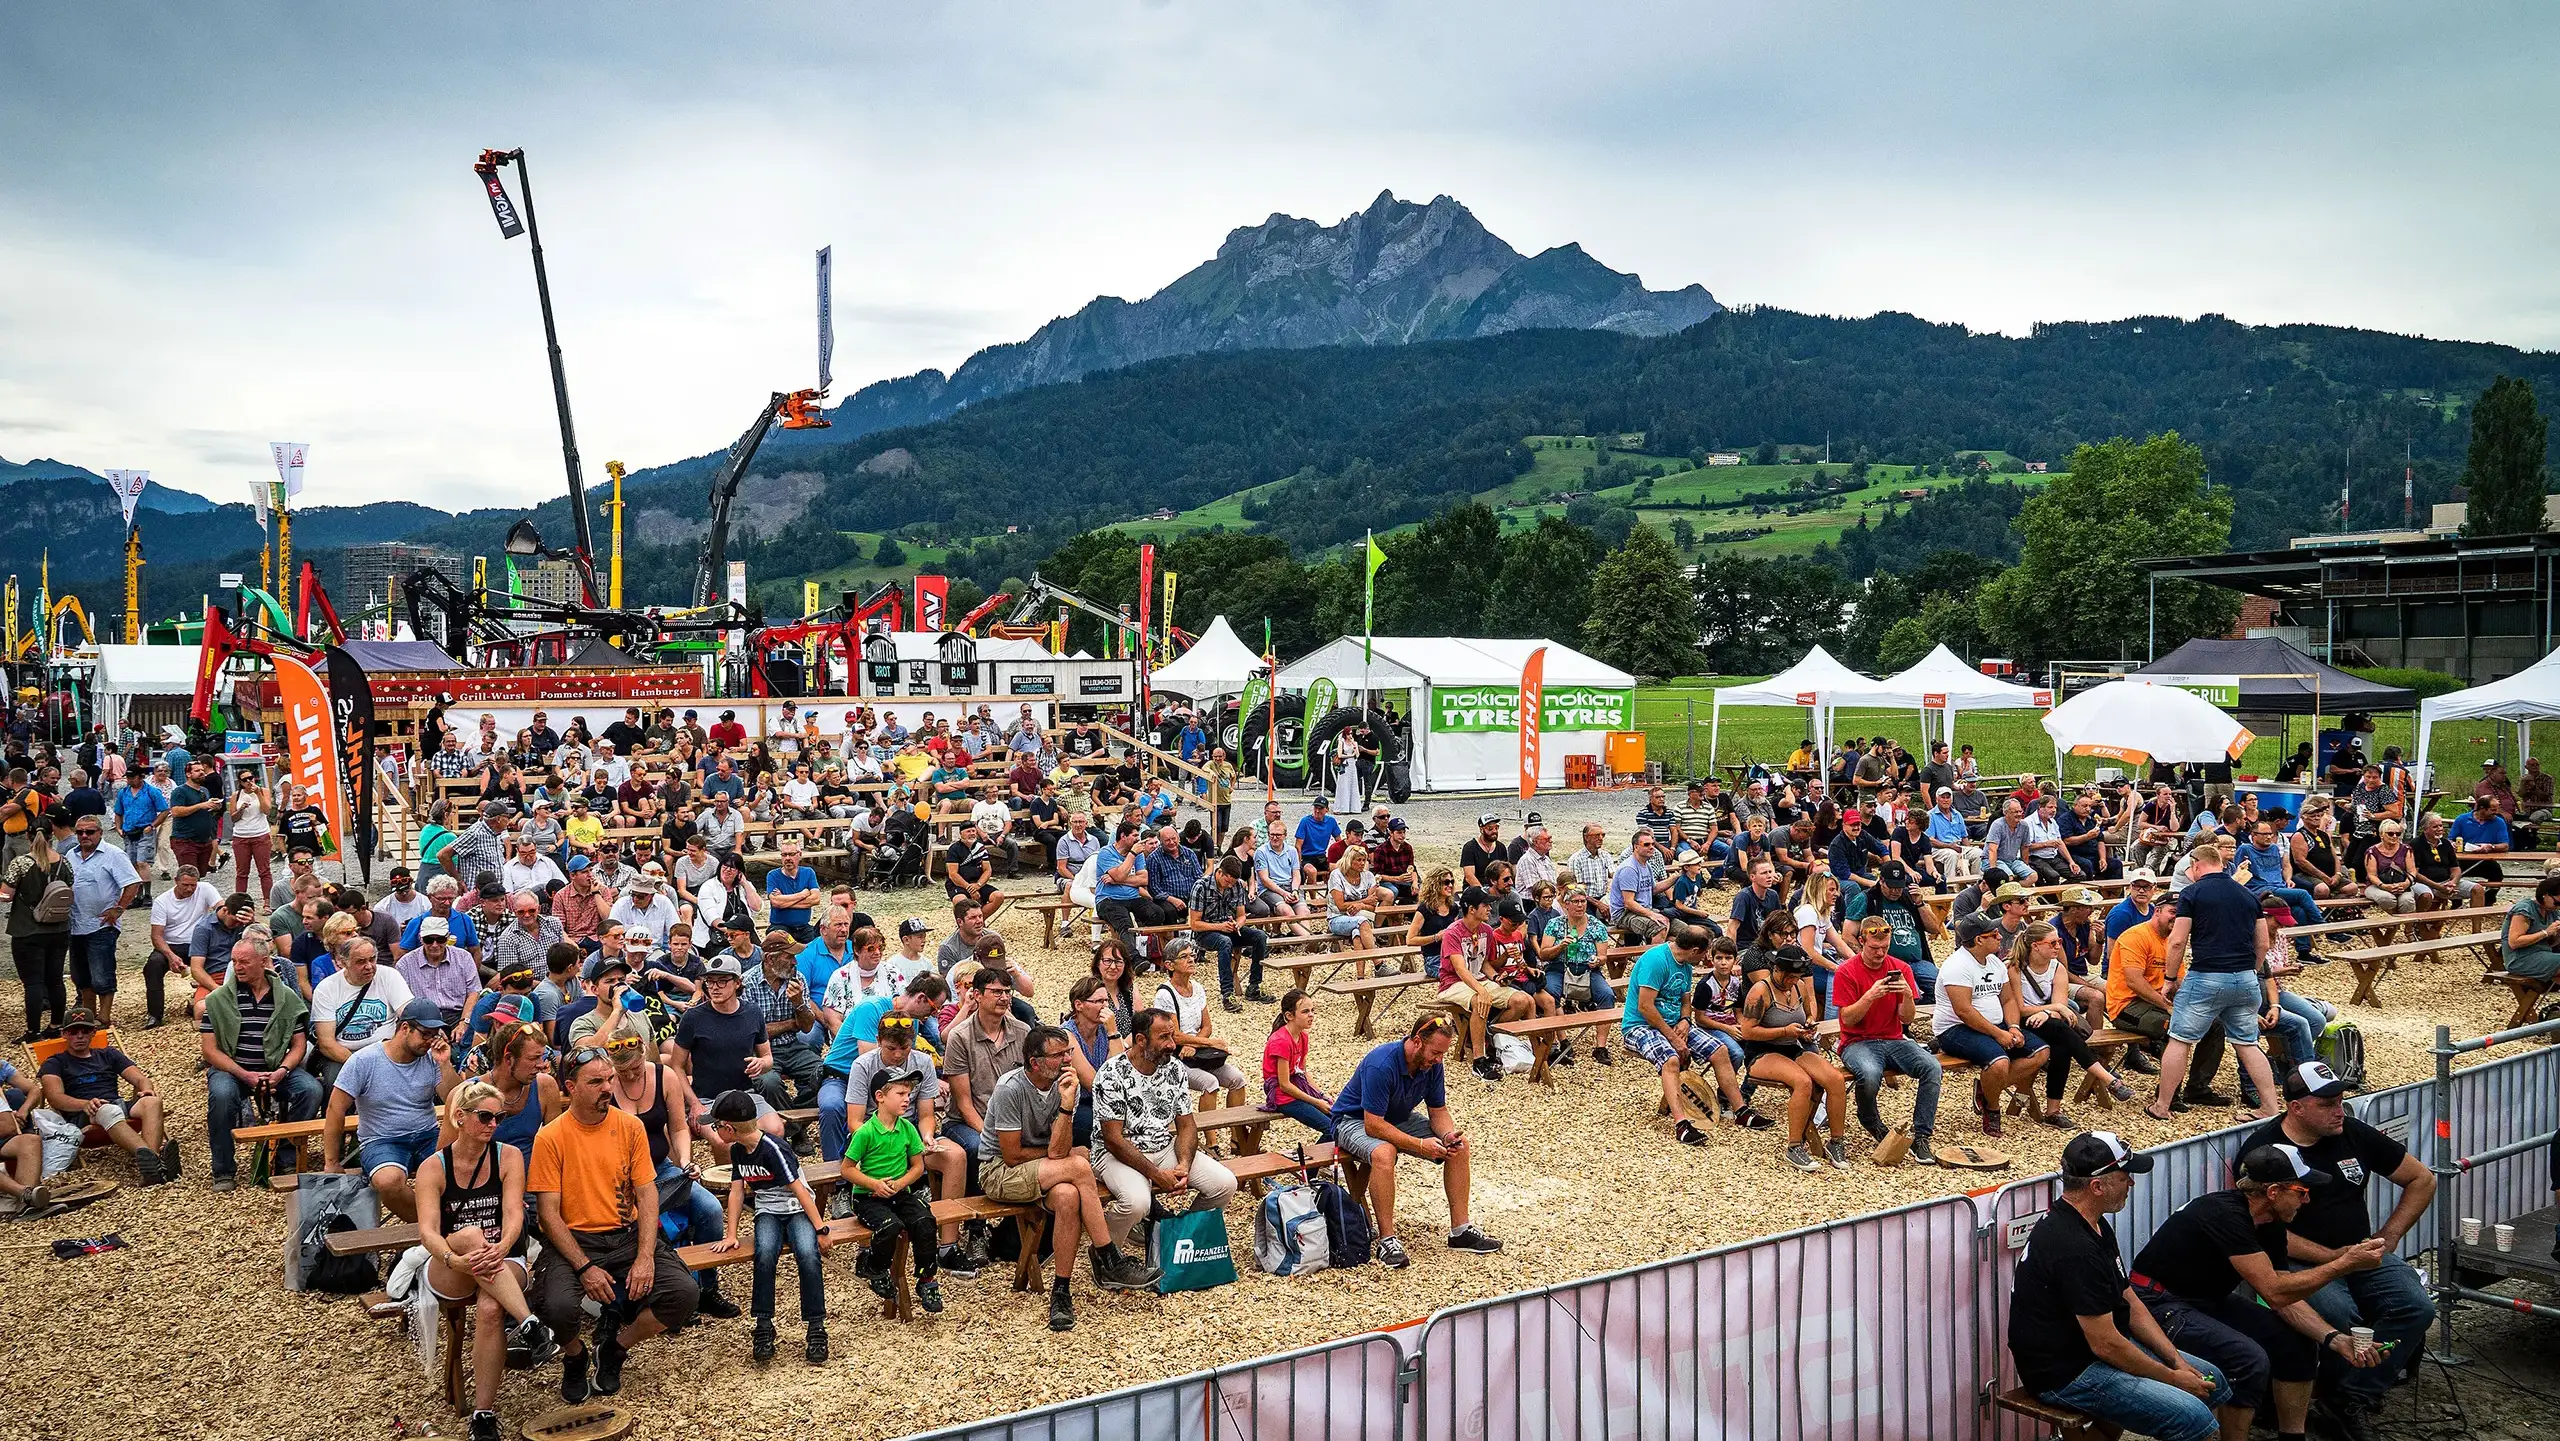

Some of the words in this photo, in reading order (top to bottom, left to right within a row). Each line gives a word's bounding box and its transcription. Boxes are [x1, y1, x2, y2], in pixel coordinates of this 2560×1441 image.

[512, 612, 542, 620] KOMATSU
[940, 638, 977, 664] CIABATTA
[875, 665, 891, 678] BROT
[951, 666, 967, 679] BAR
[412, 694, 437, 703] Frit
[459, 692, 526, 701] Grill-Wurst
[540, 691, 584, 699] Pommes
[586, 690, 617, 698] Frites
[631, 688, 691, 698] Hamburger
[2035, 695, 2051, 703] STIHL
[2188, 687, 2229, 703] GRILL
[1544, 692, 1624, 707] nokian
[1925, 697, 1944, 705] STIHL
[1544, 709, 1623, 726] TYRES
[1523, 682, 1539, 779] STIHL
[226, 735, 243, 744] Soft
[2091, 747, 2124, 758] STIHL
[366, 1004, 383, 1017] FALLS
[343, 1032, 369, 1041] CANADA
[654, 1021, 677, 1043] FOX
[1680, 1083, 1714, 1123] STIHL
[450, 1196, 499, 1212] WARNING
[1195, 1245, 1229, 1257] PFANZELT
